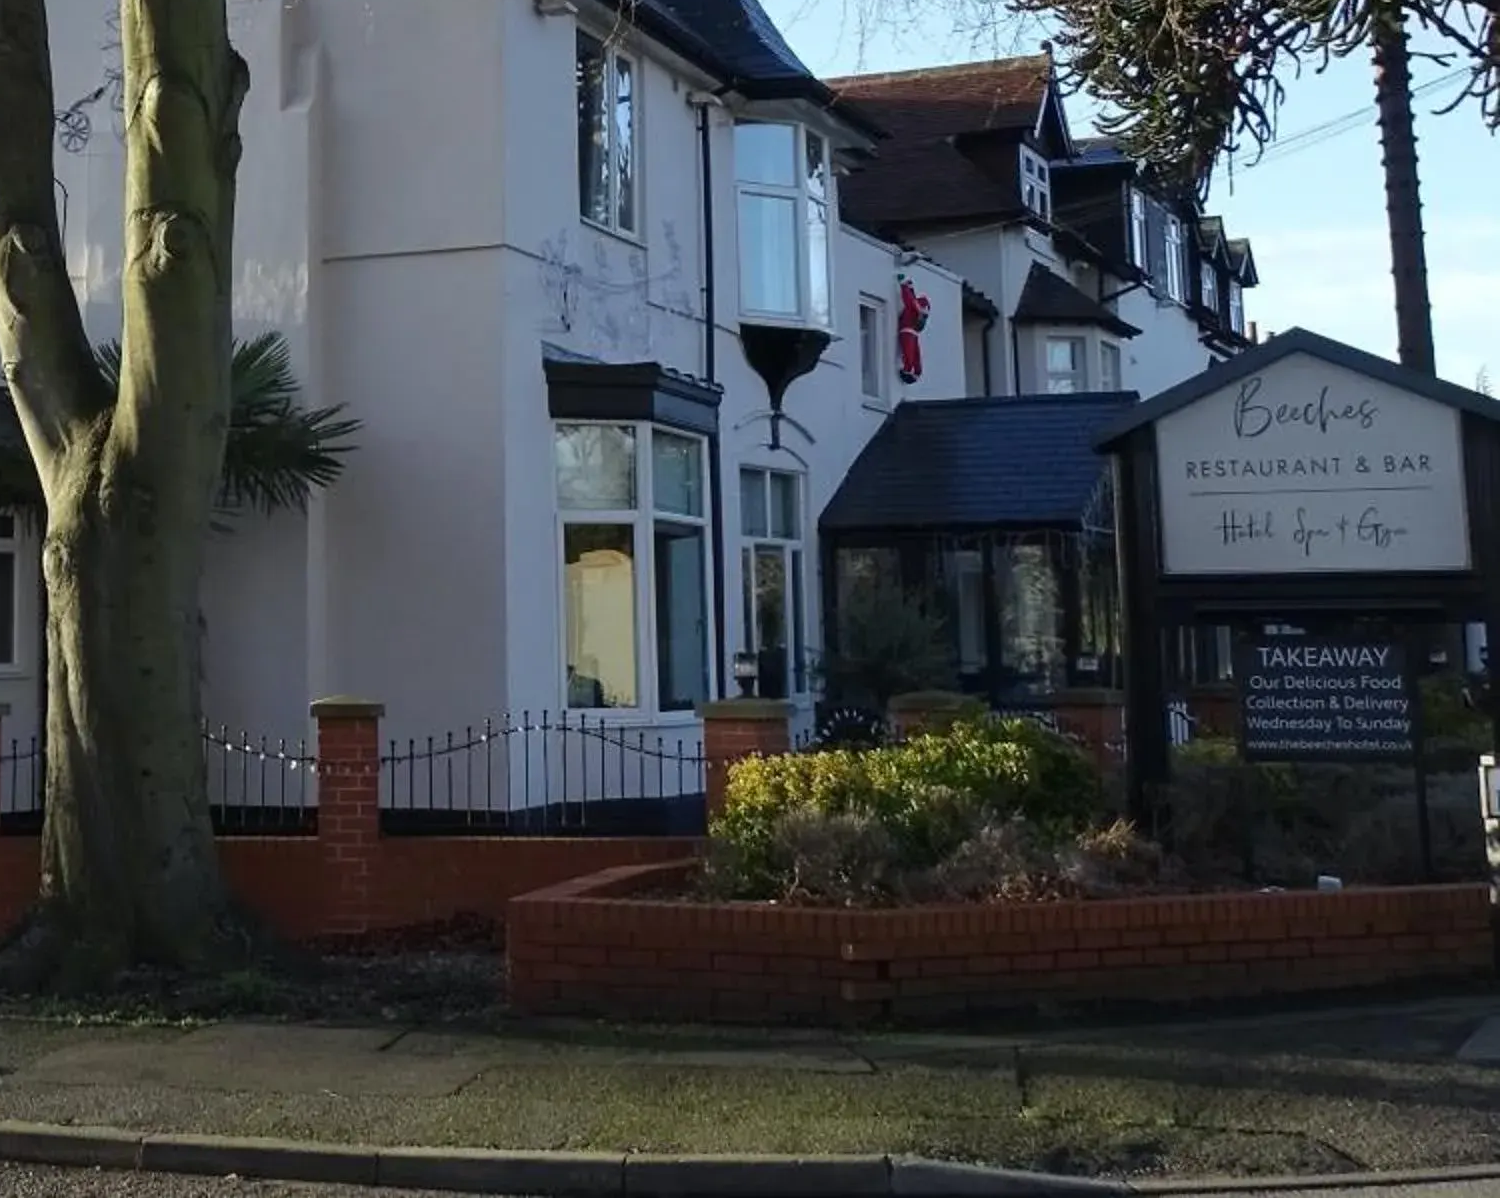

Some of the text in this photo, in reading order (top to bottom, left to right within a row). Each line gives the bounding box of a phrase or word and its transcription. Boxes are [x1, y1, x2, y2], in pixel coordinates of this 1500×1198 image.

[1234, 377, 1379, 438] Beeches
[1185, 454, 1433, 479] RESTAURANT & BAR
[1214, 509, 1275, 545] Hotel
[1293, 507, 1329, 556] Spa
[1357, 506, 1408, 548] Gym
[1256, 646, 1390, 667] TAKEAWAY
[1250, 674, 1402, 690] Our Delicious Food
[1246, 695, 1409, 713] Collection & Delivery
[1246, 716, 1412, 733] Wednesday To Sunday
